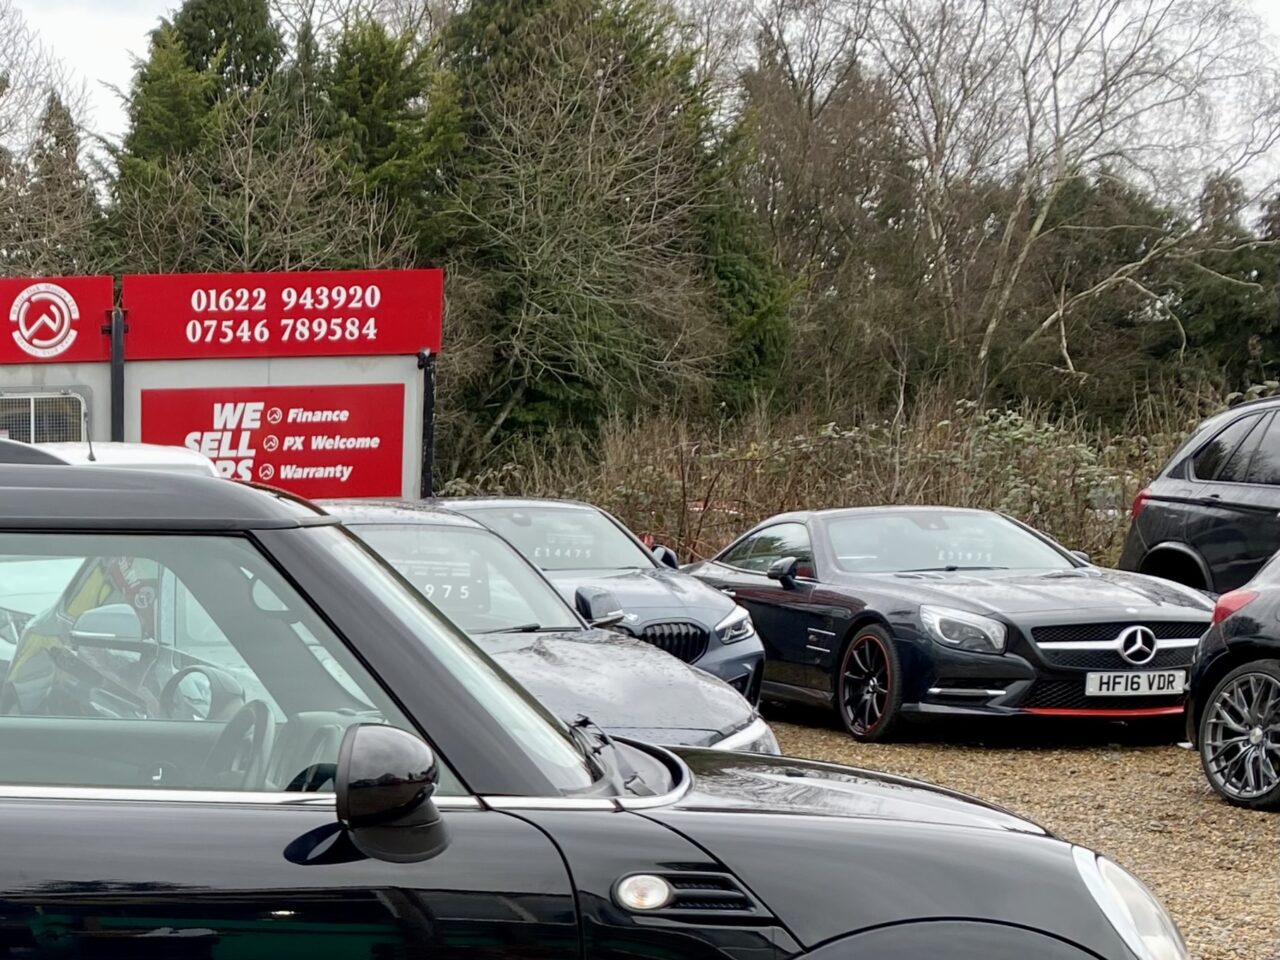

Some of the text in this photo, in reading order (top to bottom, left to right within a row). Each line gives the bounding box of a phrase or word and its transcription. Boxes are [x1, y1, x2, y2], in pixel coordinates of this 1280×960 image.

[191, 285, 381, 312] 01622 943920
[186, 317, 378, 343] 07546 789584
[213, 402, 265, 430] WE
[287, 408, 350, 424] Finance
[184, 431, 257, 458] SELL
[283, 435, 381, 451] PX Welcome
[280, 465, 353, 482] Warranty
[1098, 673, 1176, 692] HF16 VDR
